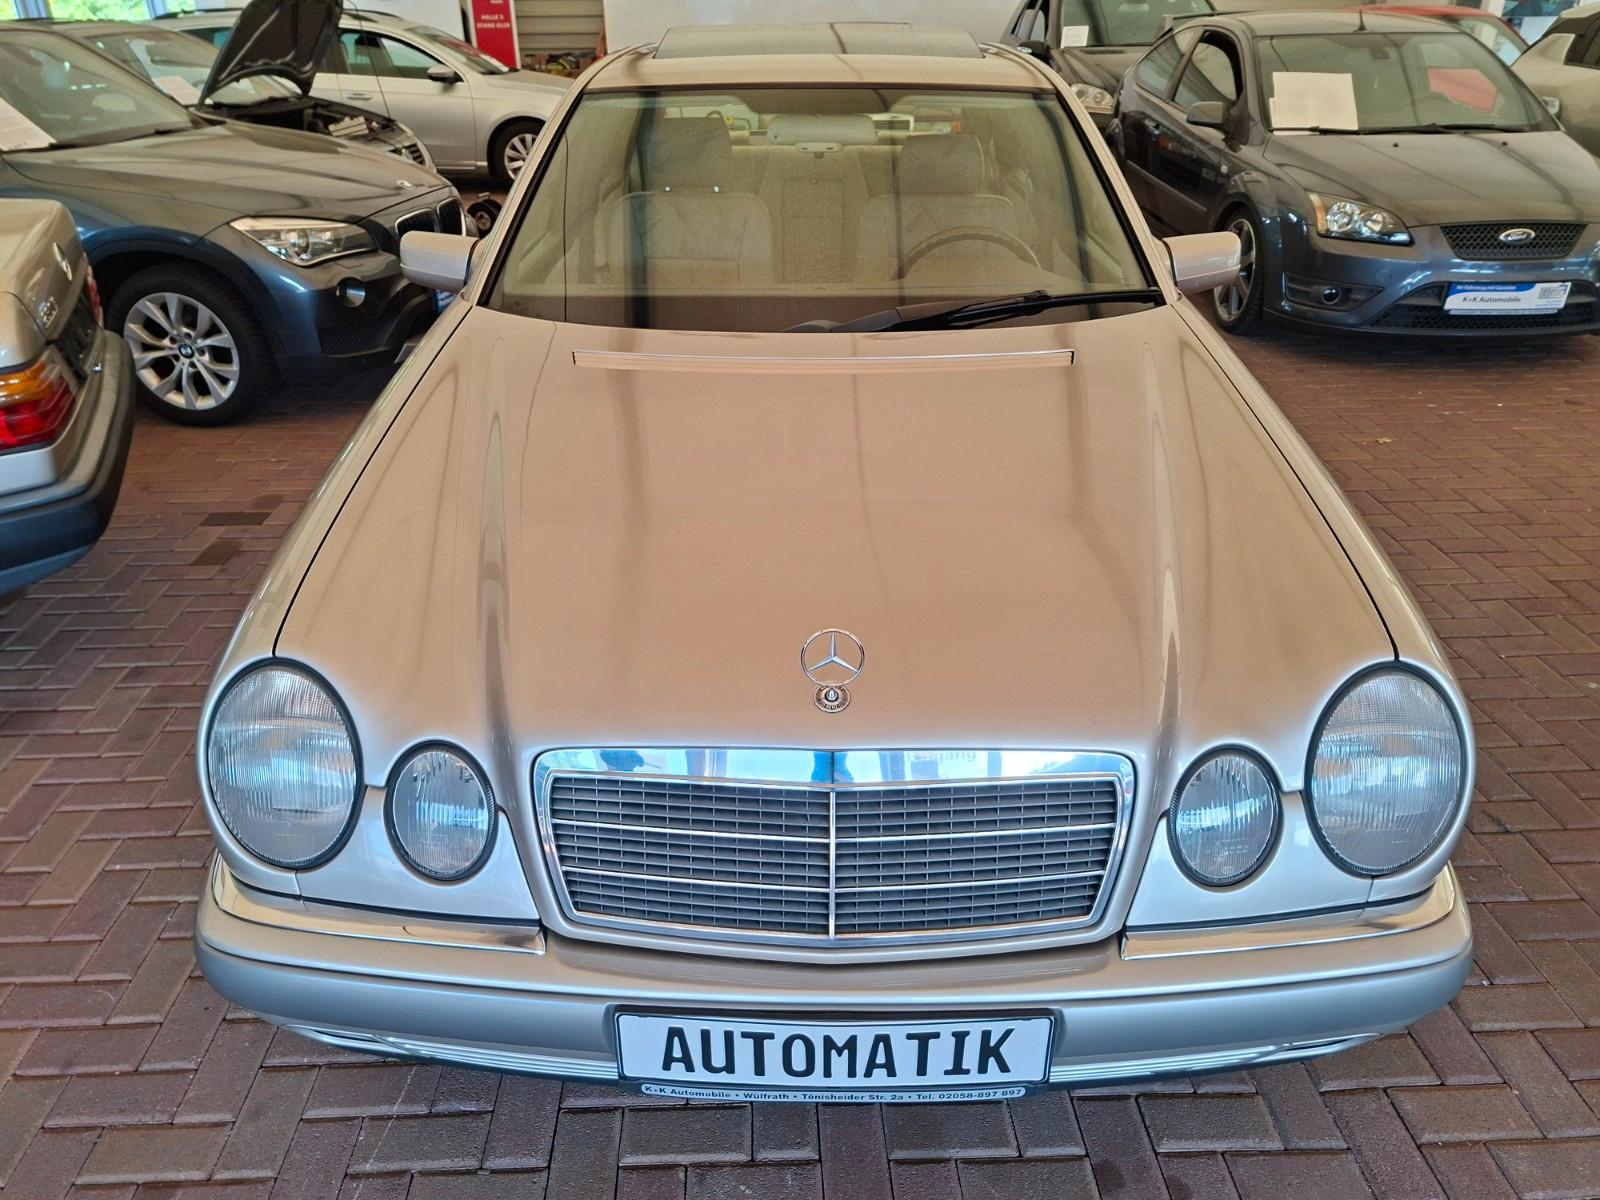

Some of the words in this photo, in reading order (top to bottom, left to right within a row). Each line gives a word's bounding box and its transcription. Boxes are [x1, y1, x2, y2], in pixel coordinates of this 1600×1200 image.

[1479, 295, 1522, 303] Automobile
[661, 1026, 1016, 1080] AUTOMATIK
[671, 1088, 731, 1098] Automobile
[743, 1091, 790, 1100] Wülfrath
[802, 1092, 866, 1101] Tönisheider
[868, 1093, 887, 1101] Str.
[916, 1092, 935, 1100] Tel.
[938, 1090, 998, 1100] 02058-897
[1001, 1088, 1023, 1097] 897
